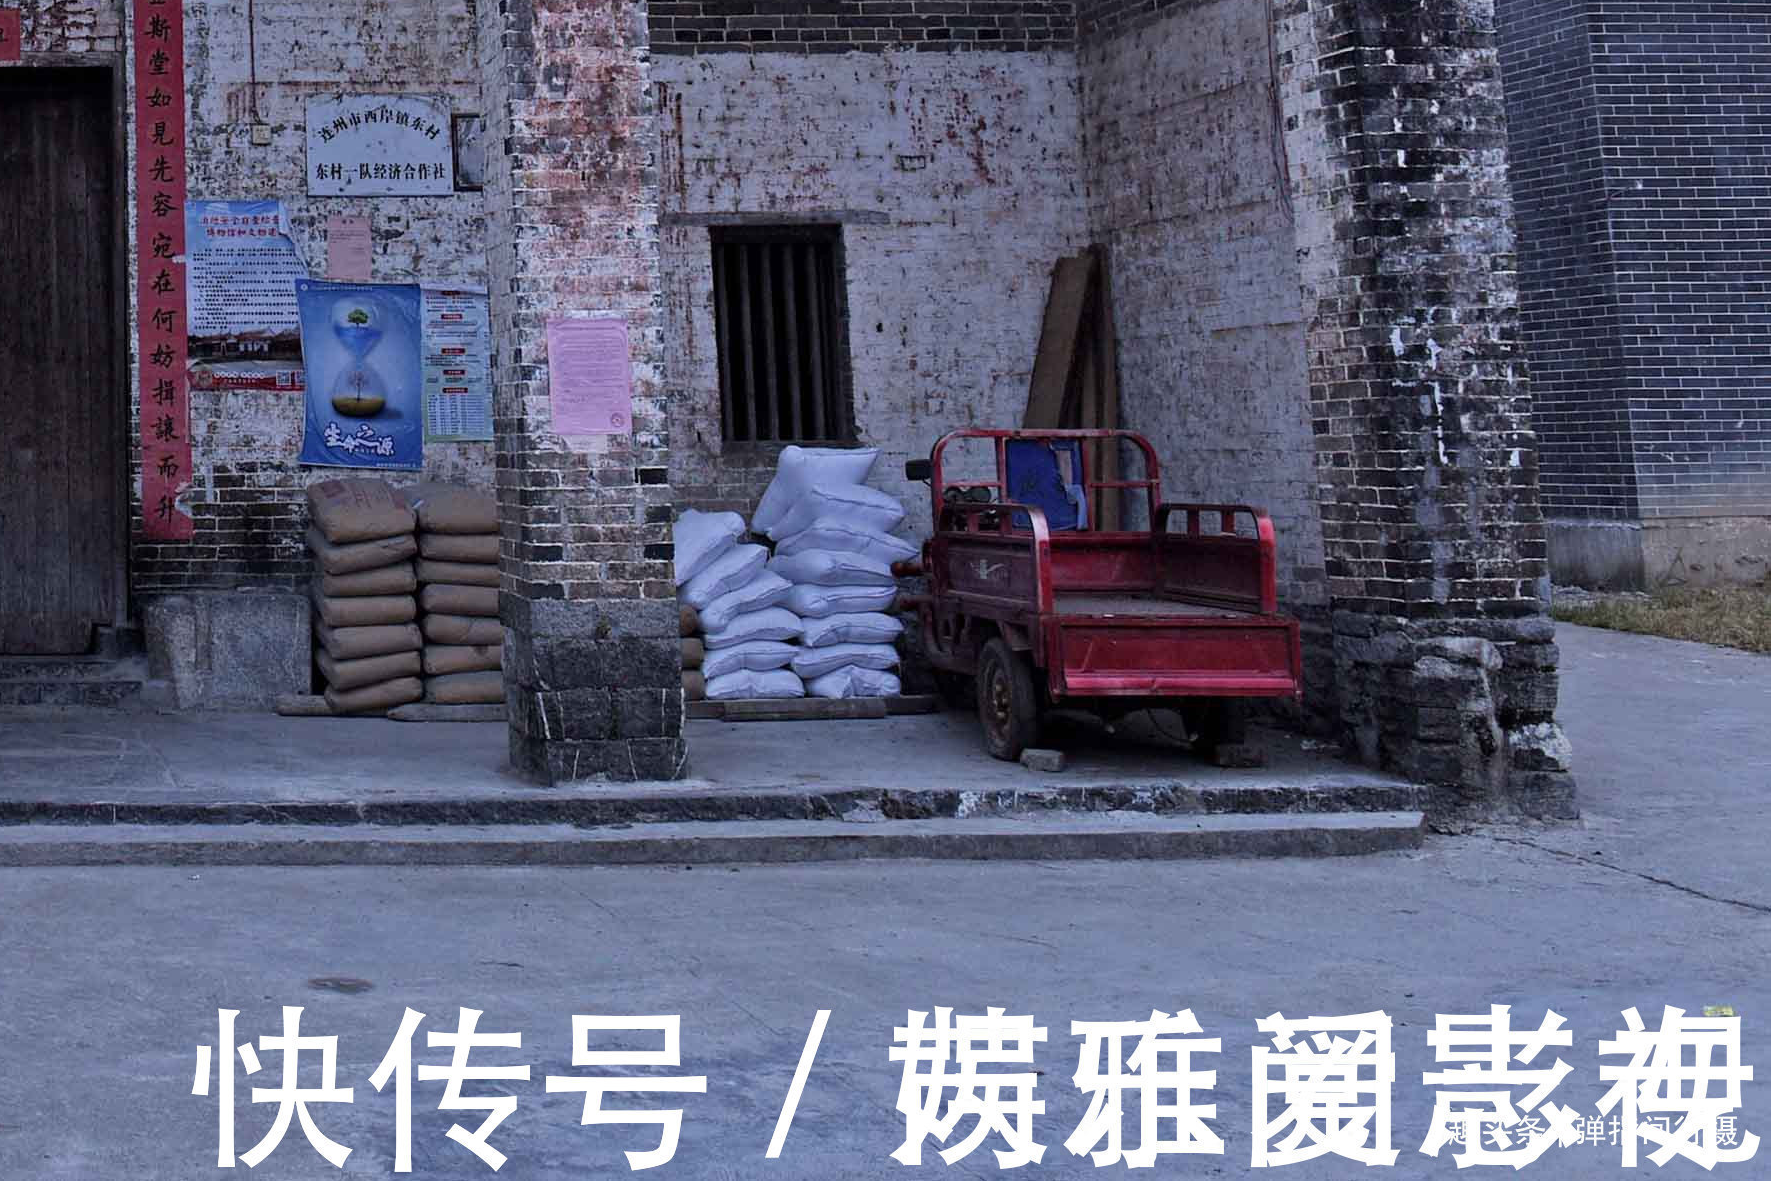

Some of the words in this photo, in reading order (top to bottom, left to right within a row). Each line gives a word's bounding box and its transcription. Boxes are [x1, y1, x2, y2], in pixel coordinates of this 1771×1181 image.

[318, 109, 440, 144] 连州市西岸镇东村
[315, 162, 446, 180] 东村一队经济合作社
[323, 421, 396, 457] 生命之源
